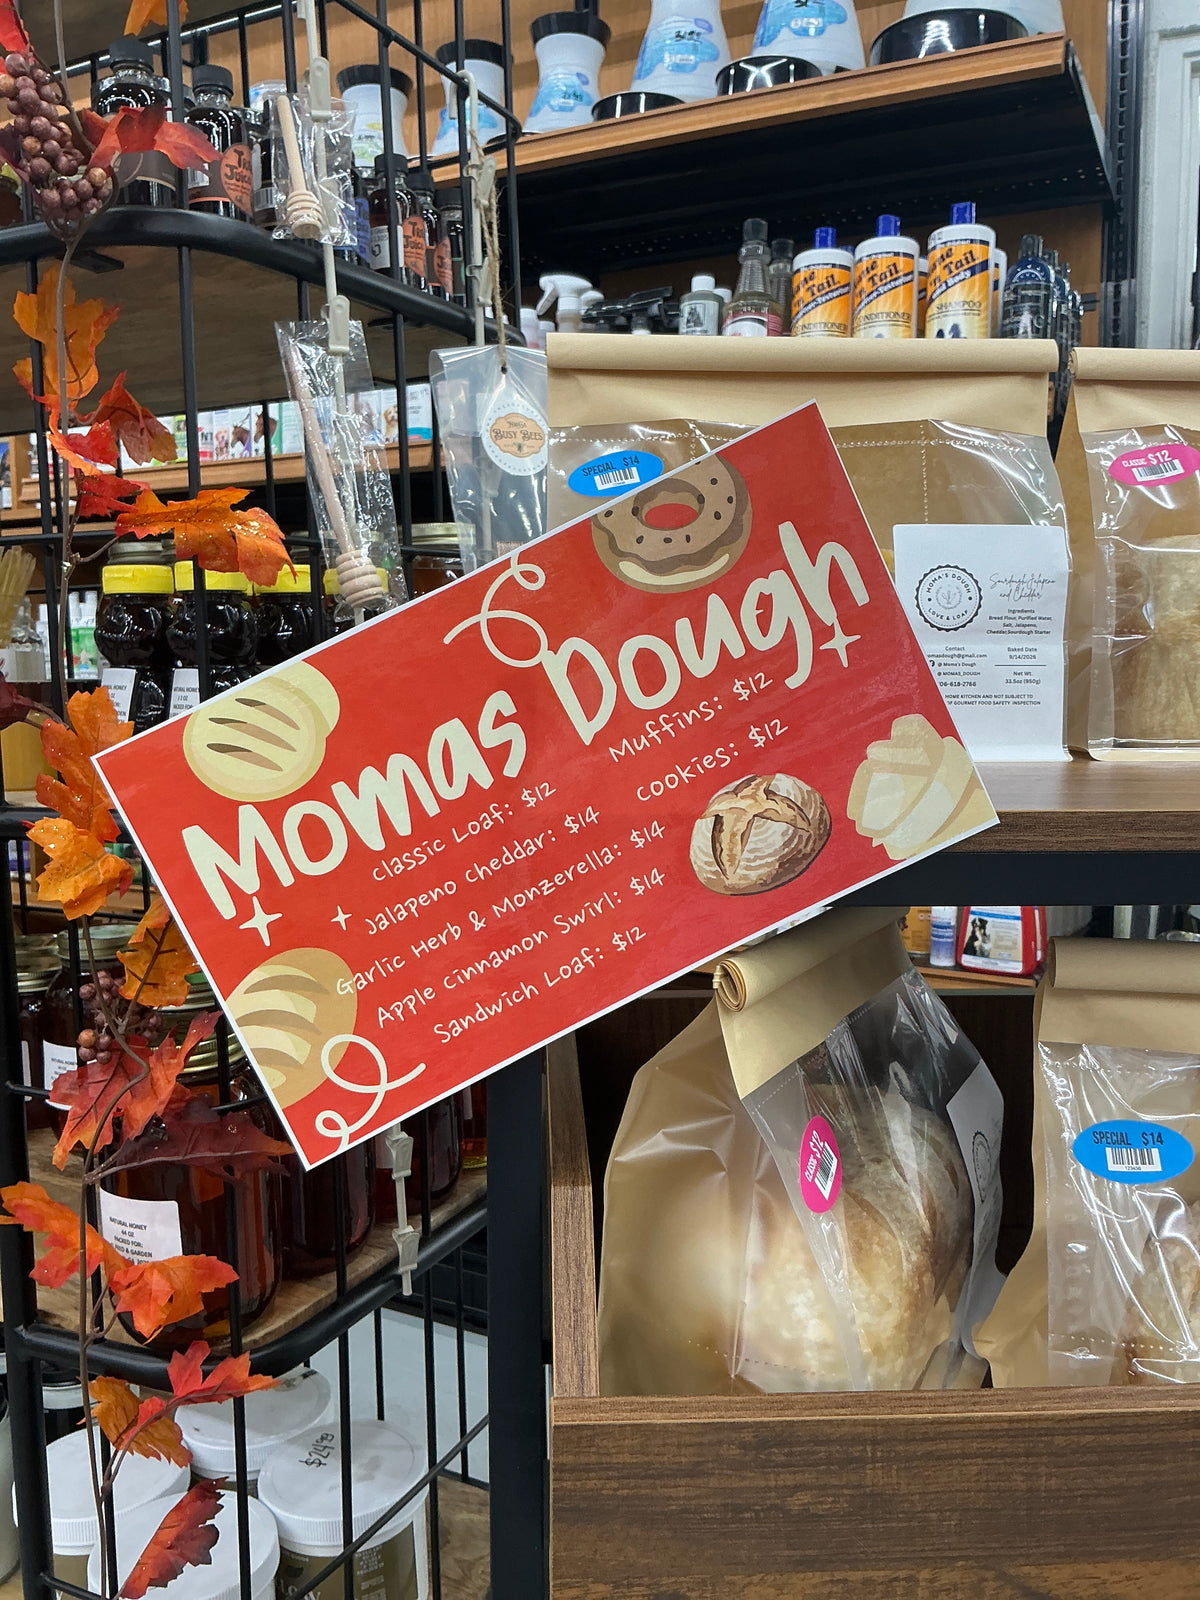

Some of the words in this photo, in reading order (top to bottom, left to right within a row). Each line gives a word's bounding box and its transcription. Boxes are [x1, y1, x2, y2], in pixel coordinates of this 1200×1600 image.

[869, 262, 900, 287] Tail
[943, 250, 976, 275] Tail
[806, 274, 837, 297] Tail
[936, 300, 982, 311] SHAMPOO
[520, 429, 544, 442] BEES
[582, 461, 617, 477] SPECIAL
[622, 455, 640, 467] $14
[1122, 457, 1148, 468] CLASSIC
[1147, 450, 1172, 465] $12
[926, 572, 949, 594] MOMA'S
[952, 573, 972, 594] DOUGH
[928, 607, 945, 620] LOVE
[952, 609, 968, 621] LOAF
[182, 690, 527, 920] Momas
[541, 521, 870, 746] Dough
[608, 696, 723, 762] Muffins:
[733, 672, 773, 701] $12
[749, 719, 789, 748] $12
[452, 803, 513, 843] Loaf:
[521, 782, 556, 808] $12
[365, 880, 457, 935] Jalapeno
[564, 805, 600, 835] $14
[336, 955, 406, 995] Garlic
[411, 922, 462, 958] Herb
[469, 910, 486, 932] &
[492, 843, 622, 918] Monzerella:
[630, 820, 666, 849] $14
[376, 985, 436, 1029] Apple
[553, 890, 622, 934] Swirl:
[629, 867, 666, 896] $14
[434, 982, 539, 1044] Sandwich
[544, 947, 604, 987] Loaf:
[611, 926, 647, 953] $12
[809, 1130, 824, 1159] $12
[1092, 1131, 1132, 1146] SPECIAL
[1141, 1132, 1164, 1146] $14
[109, 1216, 128, 1228] NATURAL
[128, 1223, 147, 1231] HONEY
[114, 1235, 130, 1246] PACKED
[131, 1240, 144, 1248] FOR:
[130, 1249, 153, 1258] GARDEN
